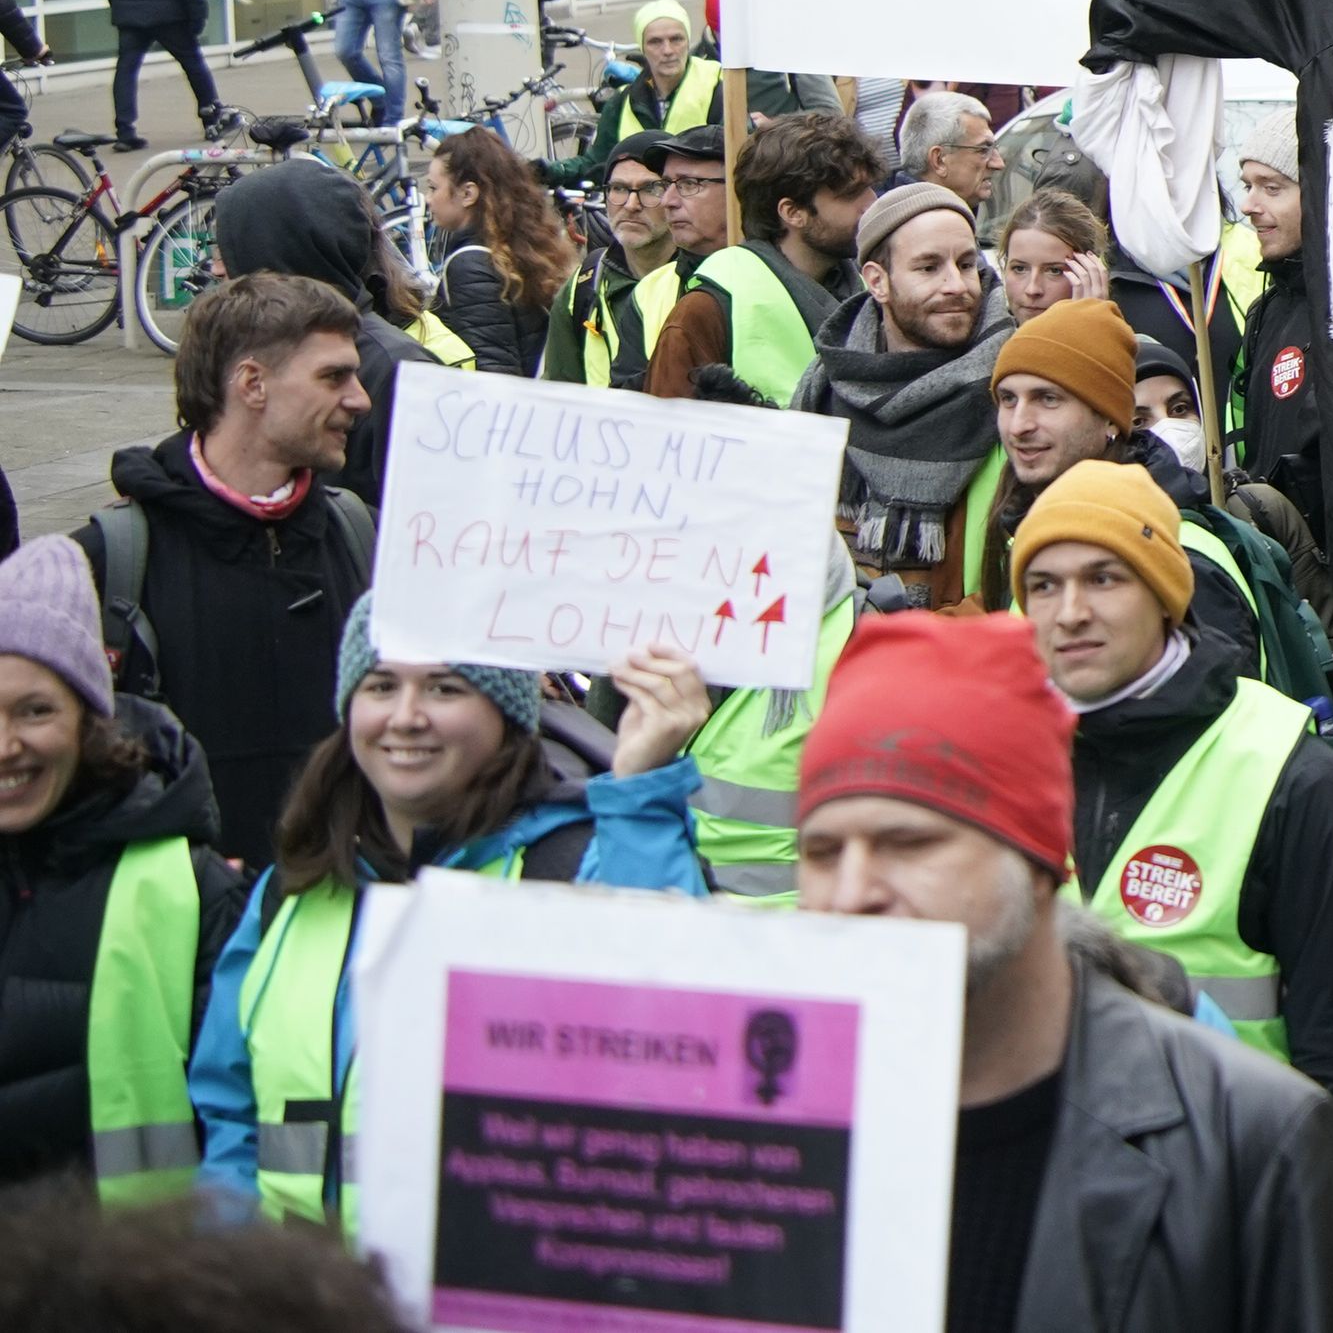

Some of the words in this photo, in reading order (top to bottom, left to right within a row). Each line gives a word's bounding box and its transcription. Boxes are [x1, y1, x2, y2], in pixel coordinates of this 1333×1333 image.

[1272, 357, 1303, 376] STREIK-
[1274, 367, 1300, 386] BEREIT
[417, 389, 637, 469] SCHLUSS
[657, 432, 748, 483] MIT
[512, 468, 690, 531] HOHN,
[407, 511, 583, 577] RAUF
[604, 532, 744, 589] DEN
[486, 590, 706, 656] LOHN
[1126, 860, 1201, 893] STREIK-
[1126, 879, 1194, 910] BEREIT
[485, 1019, 546, 1054] WIR
[556, 1025, 718, 1069] STREIKEN
